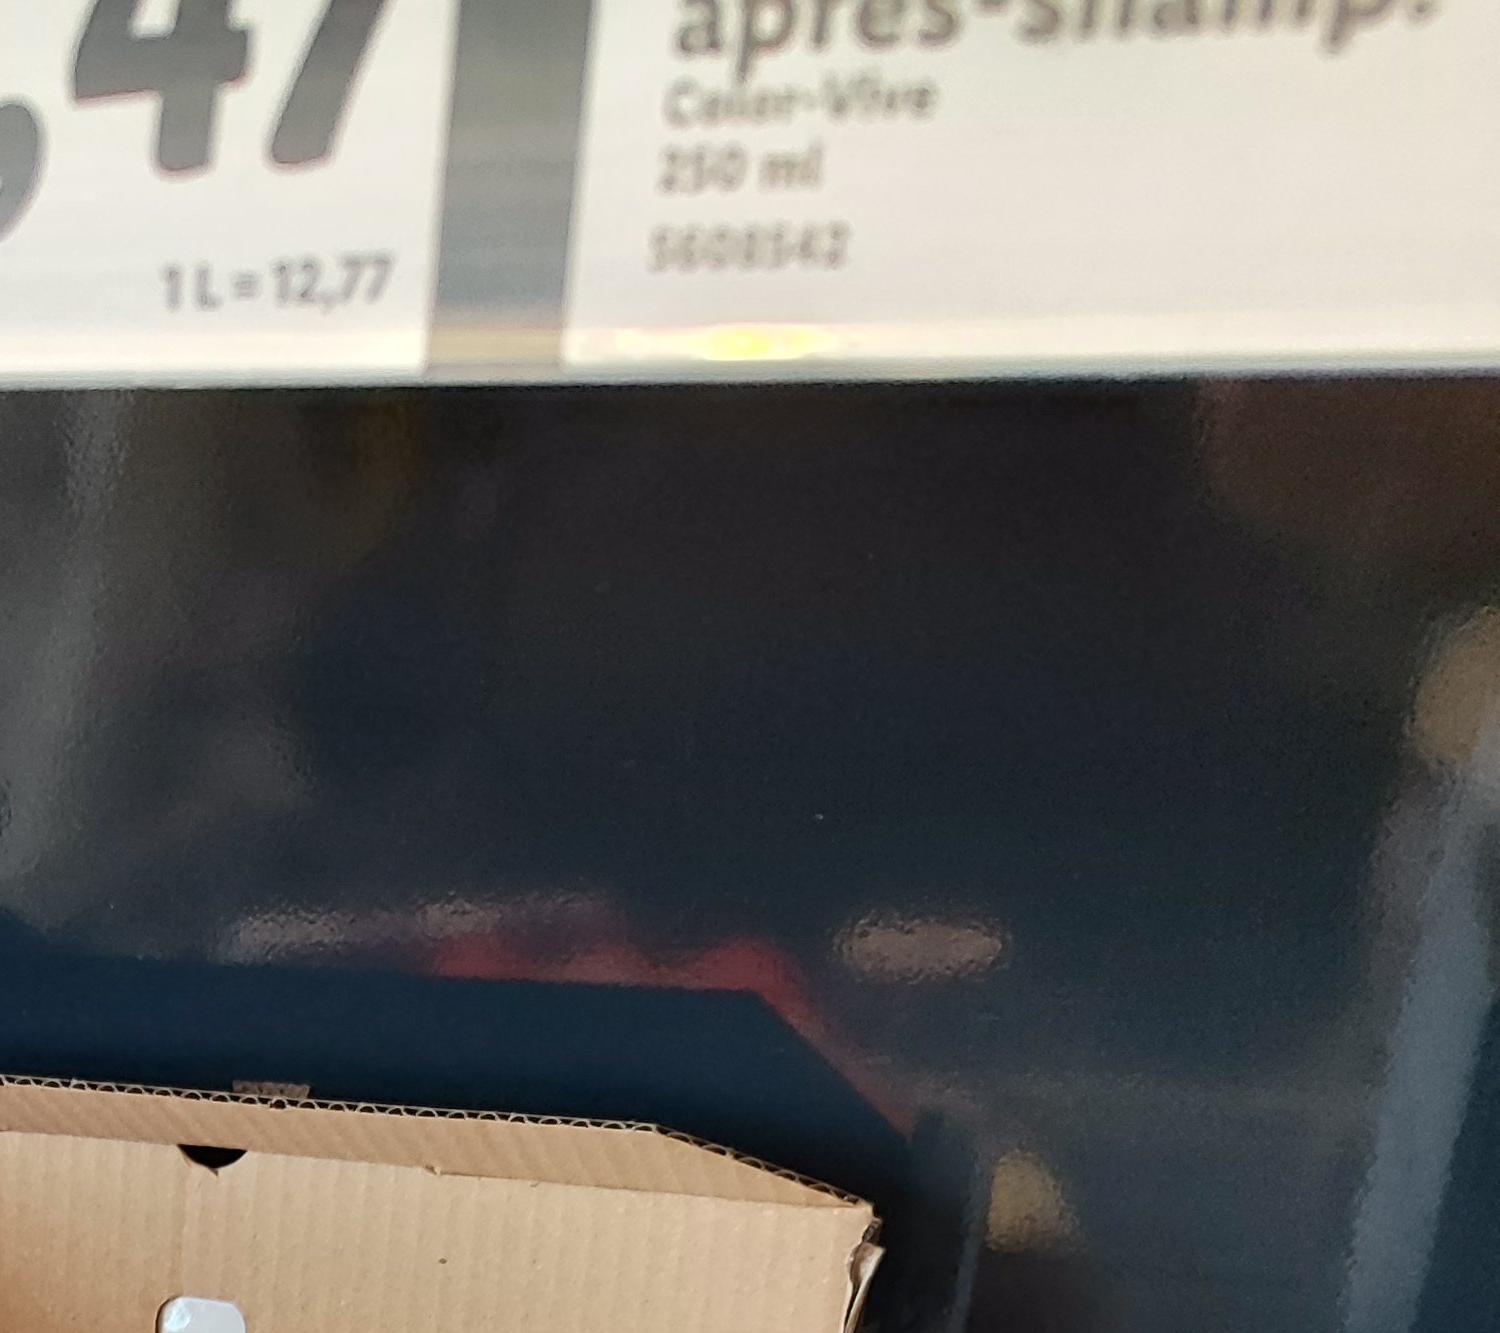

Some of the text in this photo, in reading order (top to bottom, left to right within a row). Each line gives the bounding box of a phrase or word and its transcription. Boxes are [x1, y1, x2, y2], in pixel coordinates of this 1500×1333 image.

[164, 267, 180, 309] 1
[199, 263, 218, 308] L
[274, 255, 393, 312] 12,77
